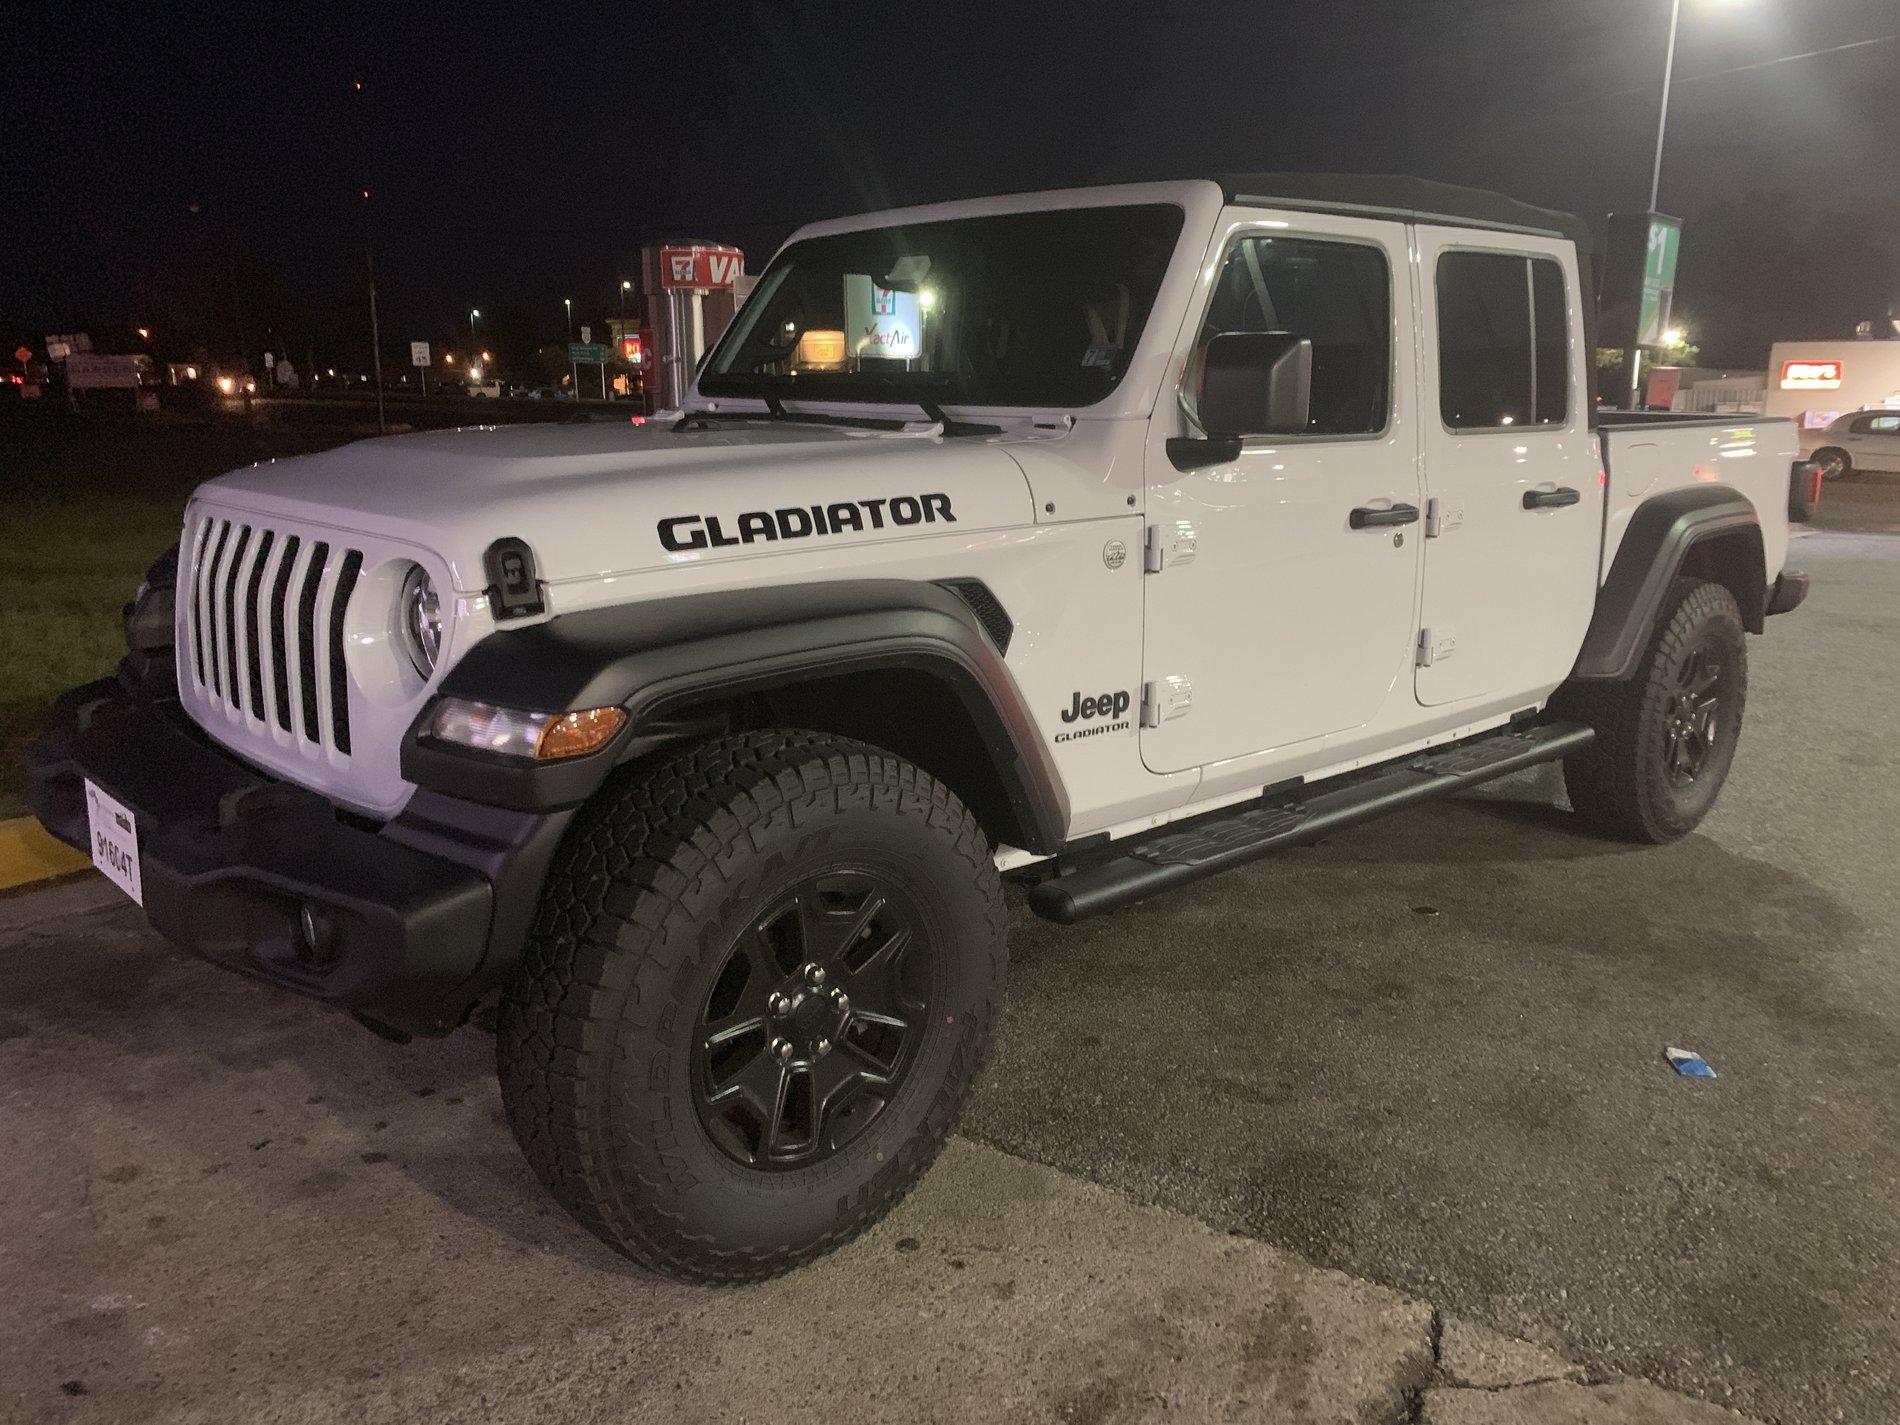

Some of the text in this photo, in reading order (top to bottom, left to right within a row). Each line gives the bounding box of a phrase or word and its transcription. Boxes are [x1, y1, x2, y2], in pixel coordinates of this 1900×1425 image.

[709, 255, 744, 284] VA
[656, 493, 957, 552] GLADIATOR
[1061, 690, 1130, 724] Jeep
[1054, 721, 1130, 744] GLADIATOR
